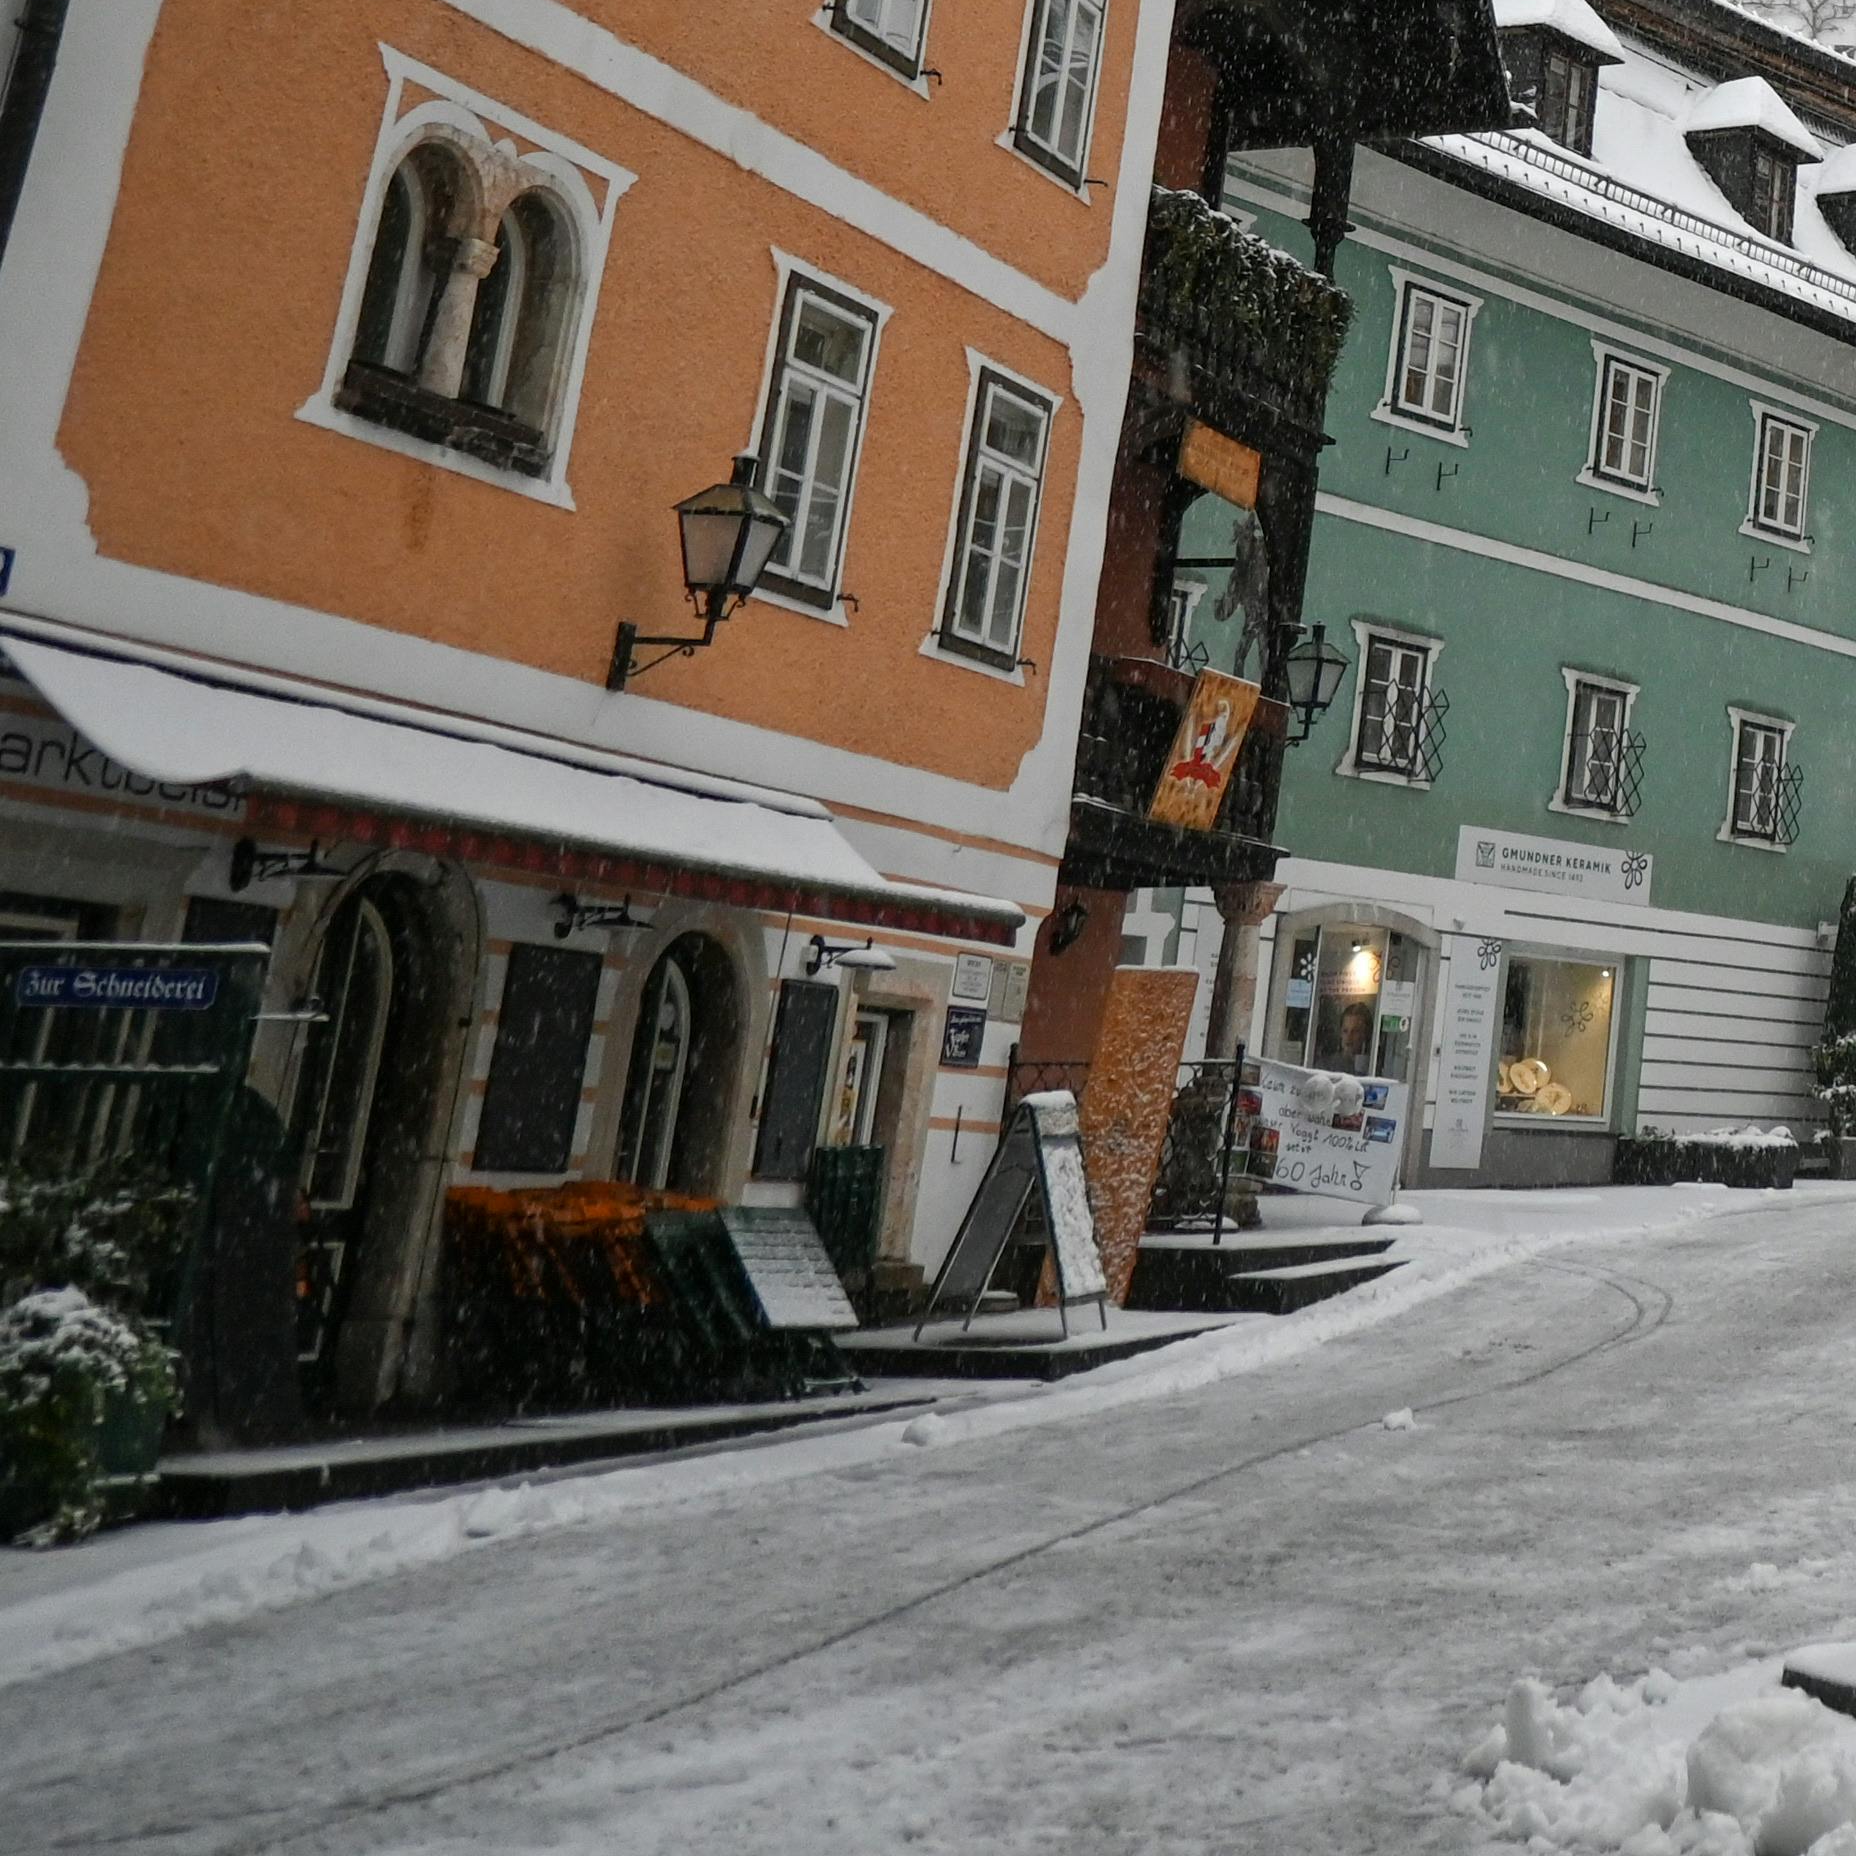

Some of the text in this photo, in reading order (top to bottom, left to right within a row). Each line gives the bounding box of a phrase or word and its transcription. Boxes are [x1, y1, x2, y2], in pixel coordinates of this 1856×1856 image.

[1501, 864, 1542, 878] HANDMADE
[1545, 870, 1566, 881] SINCE
[1502, 847, 1611, 874] GMUNDNER KERAMIK
[74, 971, 206, 1000] Schneiderei
[1276, 1158, 1305, 1182] 60
